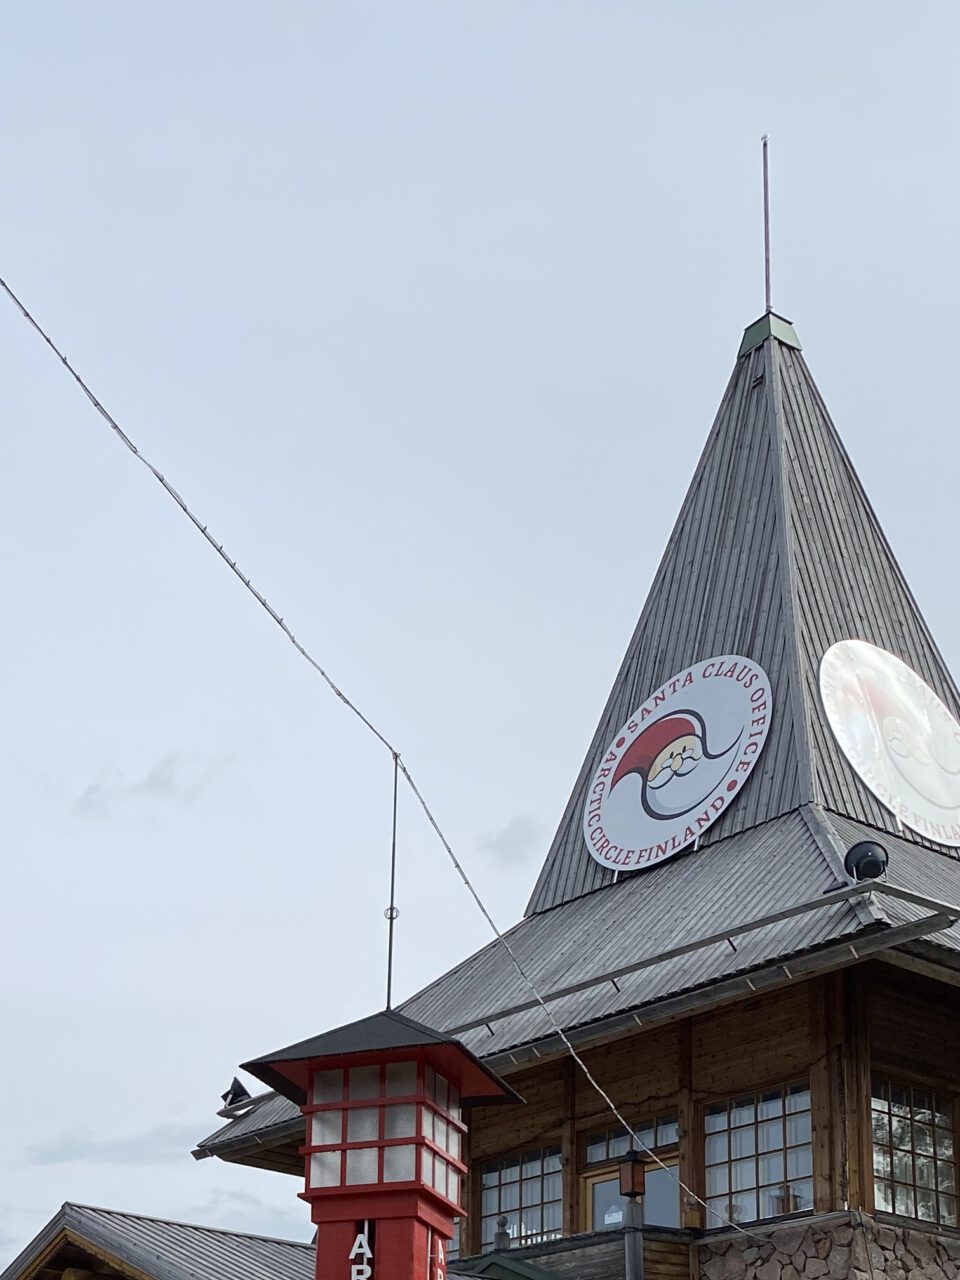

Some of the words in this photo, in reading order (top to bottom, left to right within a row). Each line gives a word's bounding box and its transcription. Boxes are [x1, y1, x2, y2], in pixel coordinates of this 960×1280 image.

[627, 672, 694, 734] SANTA
[702, 660, 759, 689] CLAUS
[735, 686, 767, 773] OFFICE
[588, 751, 617, 828] ARCTIC
[590, 826, 635, 866] CIRCLE
[634, 795, 726, 866] FINLAND
